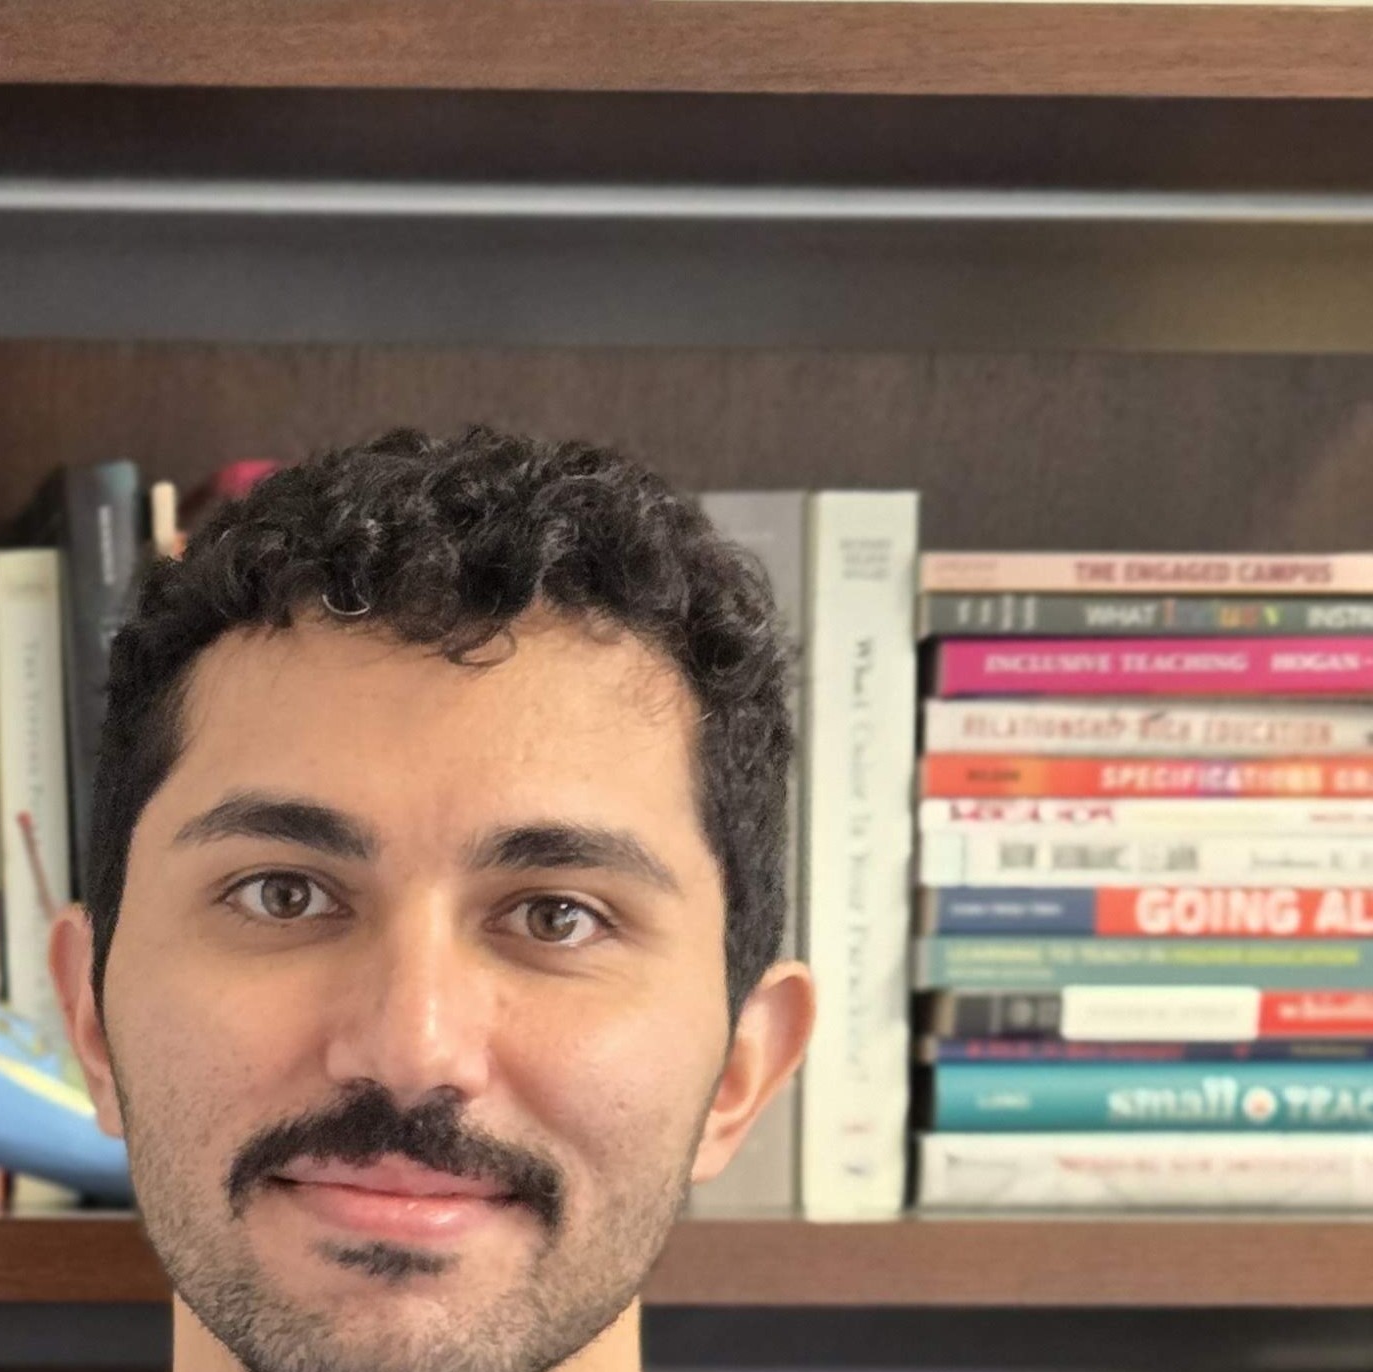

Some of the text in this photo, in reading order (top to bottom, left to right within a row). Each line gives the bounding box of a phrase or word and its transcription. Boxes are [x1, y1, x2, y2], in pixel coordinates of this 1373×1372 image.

[1075, 561, 1334, 584] THE ENGAGED CAMPUS
[1084, 602, 1158, 627] WHAT
[984, 652, 1360, 673] INCLUSIVE TEACHING HOGAN
[1100, 765, 1324, 792] SPECIFICATIONS
[1133, 888, 1302, 935] GOING
[1107, 1075, 1239, 1120] small
